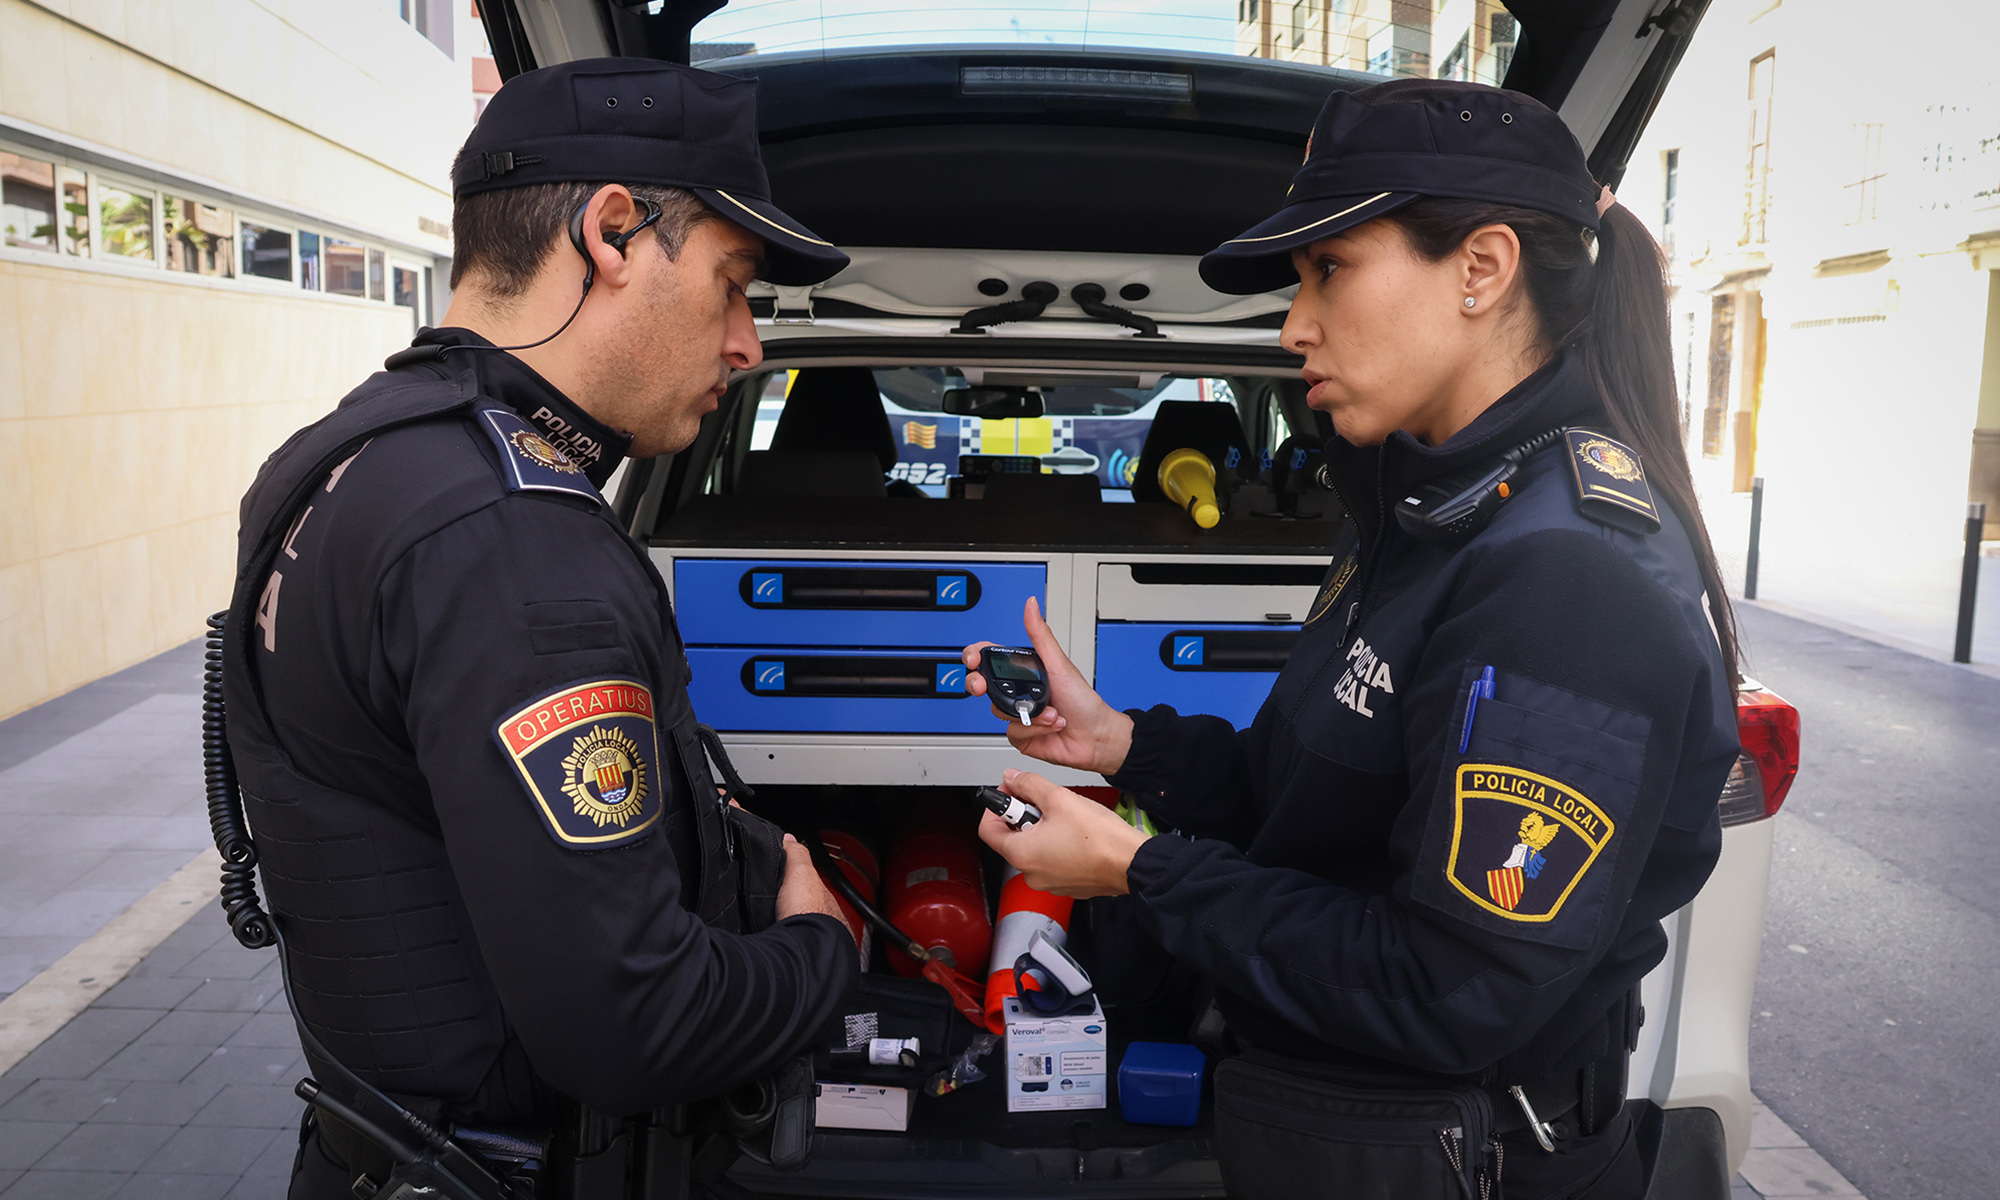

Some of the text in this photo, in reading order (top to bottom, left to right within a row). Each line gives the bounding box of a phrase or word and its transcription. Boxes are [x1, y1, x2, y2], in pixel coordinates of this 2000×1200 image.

[531, 406, 602, 461] POLICIA
[890, 462, 947, 484] 092
[517, 689, 647, 741] OPERATIUS
[577, 740, 629, 769] POLICIA LOCAL
[607, 802, 628, 811] ONDA
[1473, 773, 1597, 836] POLICIA LOCAL
